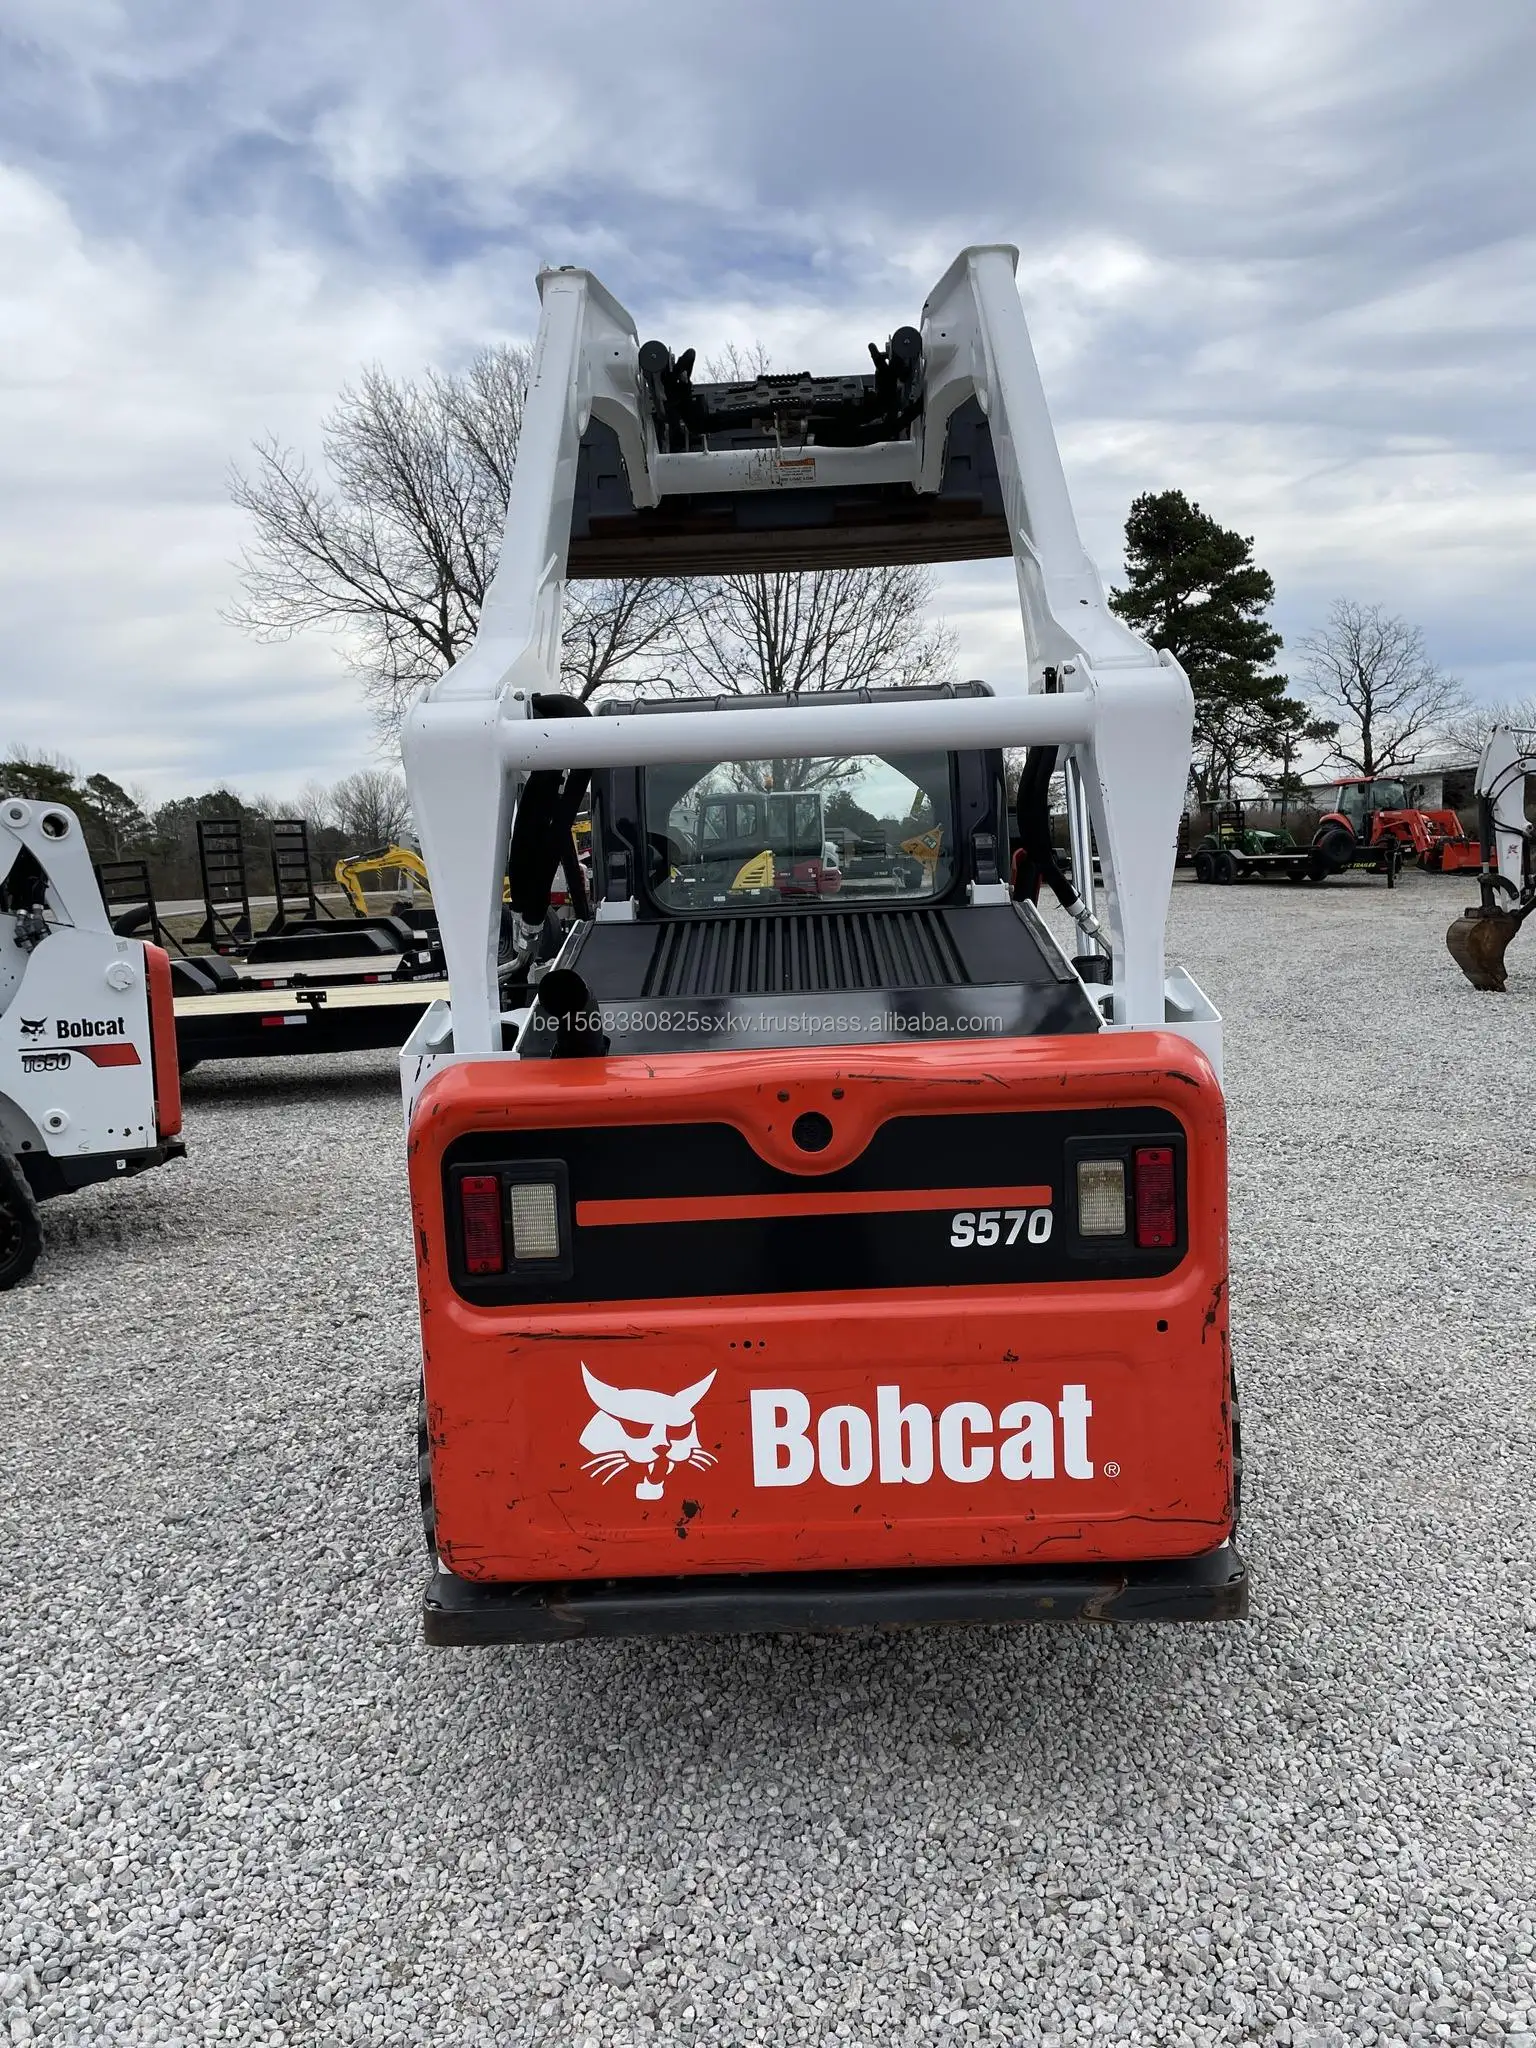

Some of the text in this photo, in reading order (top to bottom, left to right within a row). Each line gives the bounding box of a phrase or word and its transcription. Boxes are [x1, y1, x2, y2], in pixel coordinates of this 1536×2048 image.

[56, 1016, 125, 1039] Bobcat
[21, 1053, 71, 1073] T650
[950, 1208, 1053, 1248] S570
[750, 1384, 1094, 1487] Bobcat
